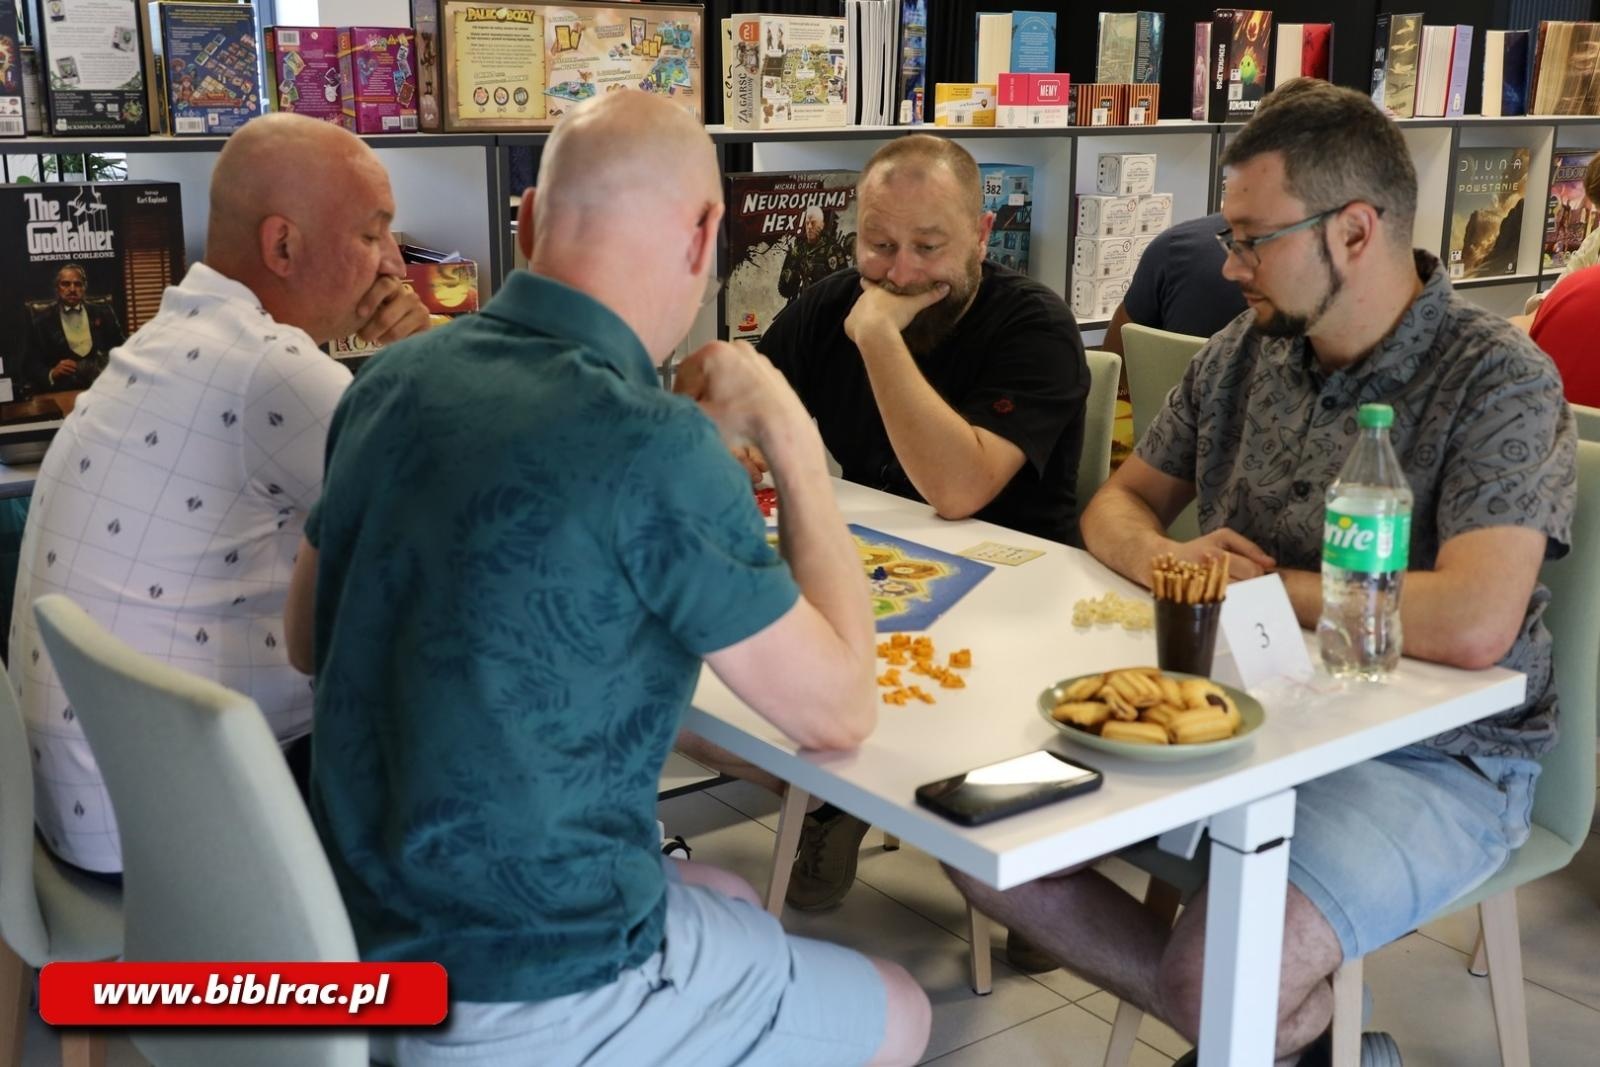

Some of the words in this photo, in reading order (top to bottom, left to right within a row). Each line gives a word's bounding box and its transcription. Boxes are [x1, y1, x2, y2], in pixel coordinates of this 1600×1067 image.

[1040, 85, 1058, 97] MEMY
[985, 184, 1002, 195] 382
[1458, 182, 1519, 193] POWSTANIE
[24, 193, 61, 221] The
[742, 191, 846, 214] NEUROSHIMA
[26, 220, 114, 254] Godfather
[30, 253, 72, 262] IMPERIUM
[72, 251, 115, 260] CORLEONE
[1254, 622, 1271, 649] 3
